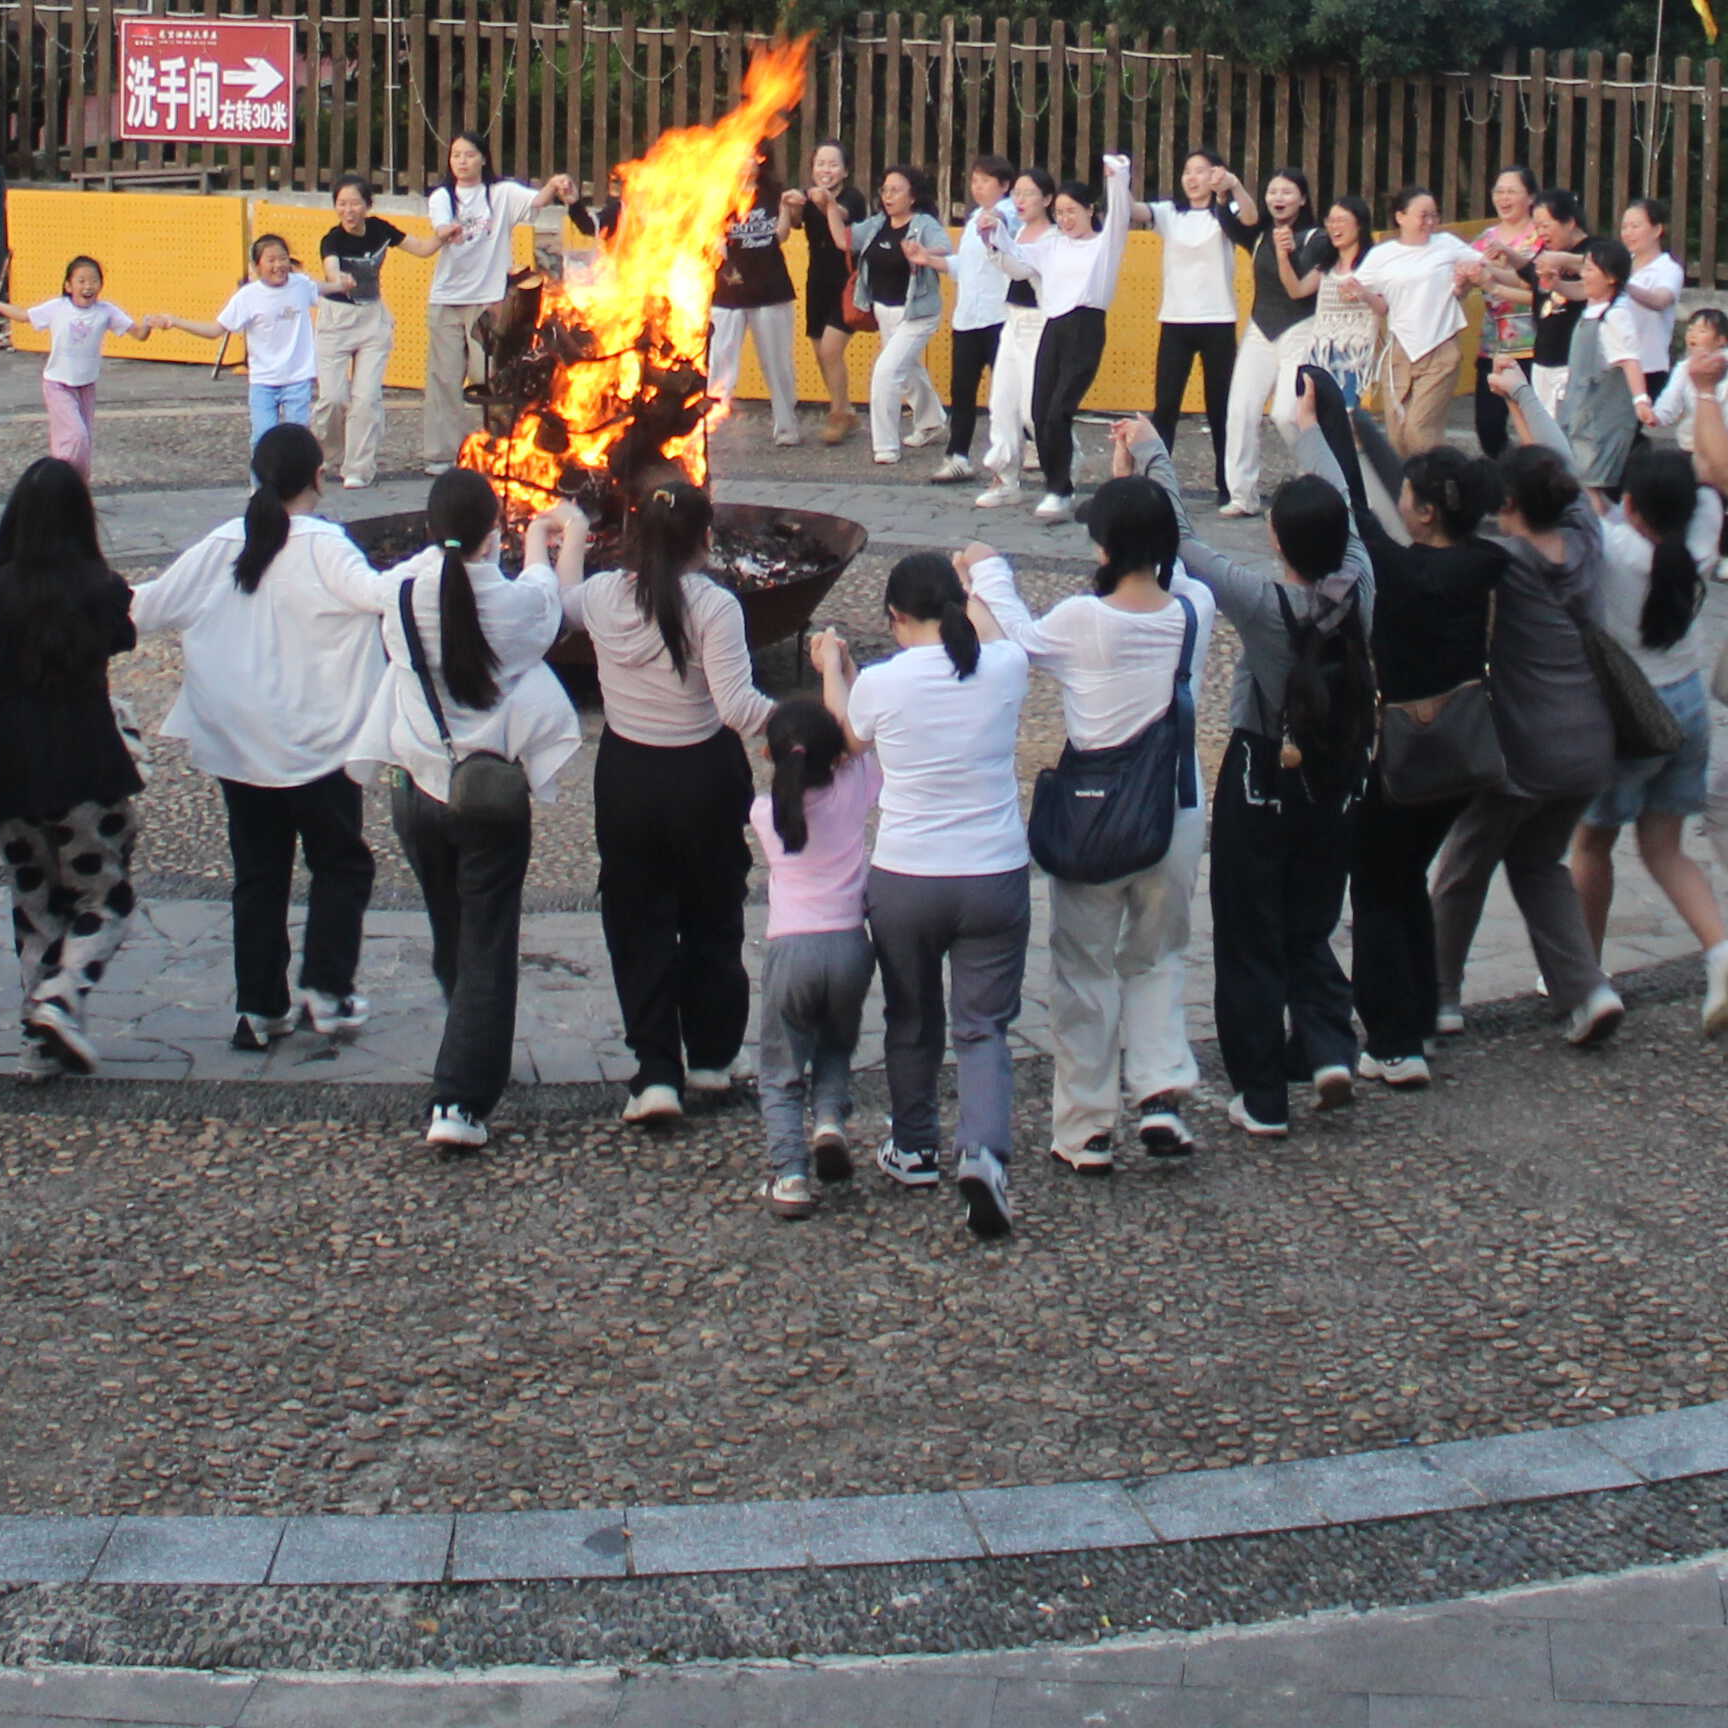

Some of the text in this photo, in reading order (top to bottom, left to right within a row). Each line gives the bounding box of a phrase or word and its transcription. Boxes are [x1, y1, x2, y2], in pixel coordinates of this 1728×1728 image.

[127, 56, 218, 130] 洗手间
[220, 101, 287, 132] 右转30米
